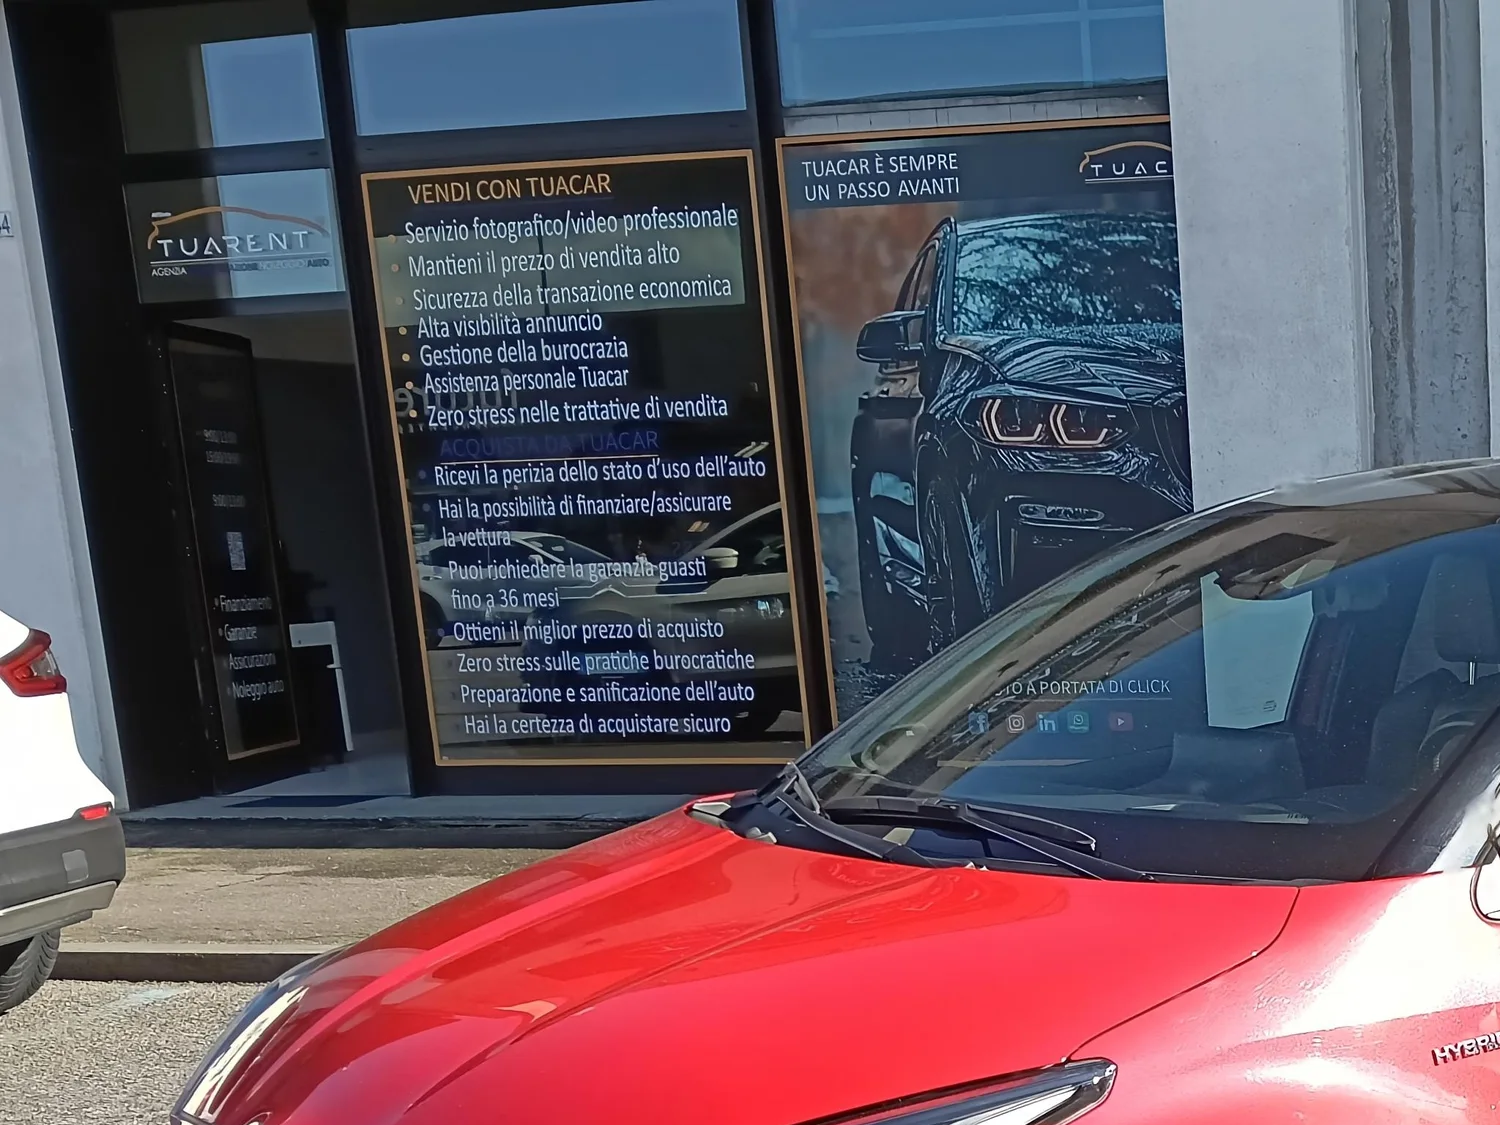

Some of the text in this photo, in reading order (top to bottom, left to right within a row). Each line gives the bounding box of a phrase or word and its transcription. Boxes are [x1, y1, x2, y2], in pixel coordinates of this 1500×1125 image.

[801, 153, 959, 178] TUACAR È SEMPRE
[1090, 161, 1168, 177] TUAC
[408, 173, 612, 204] VENDI CON TUACAR
[804, 177, 960, 202] UN PASSO AVANTI
[405, 202, 739, 244] Servizio fotografico/video professionale
[157, 231, 308, 257] TUARENT
[151, 266, 187, 278] AGENZIA
[408, 241, 681, 278] Mantieni il prezzo di vendita alto
[413, 274, 732, 311] Sicurezza della transazione economica
[418, 309, 603, 339] Alta visibilità annuncio
[420, 336, 629, 366] Gestione della burocrazia
[425, 365, 629, 396] Assistenza personale Tuacar
[427, 405, 465, 427] Zero
[469, 404, 516, 426] stress
[520, 399, 560, 424] nelle
[564, 398, 641, 422] trattative
[645, 395, 661, 419] di
[664, 393, 729, 417] vendita
[440, 431, 660, 458] ACQUISTA DA TUACAR
[434, 464, 480, 487] Ricevi
[484, 463, 498, 485] la
[503, 463, 555, 489] perizia
[559, 459, 599, 482] dello
[602, 461, 643, 481] stato
[438, 491, 732, 523] Hai la possibilità di finanziare/assicurare
[442, 526, 512, 548] la vettura
[448, 555, 707, 583] Puoi richiedere la garanzia guasti
[451, 587, 560, 610] fino a 36 mesi
[453, 618, 724, 645] Ottieni il miglior prezzo di acquisto
[457, 648, 755, 676] Zero stress sulle pratiche burocratiche
[460, 684, 562, 708] Preparazione
[566, 687, 576, 702] e
[580, 681, 681, 702] sanificazione
[1026, 680, 1037, 695] A
[1040, 680, 1105, 695] PORTATA
[1109, 679, 1124, 694] DI
[1127, 679, 1171, 694] CLICK
[464, 713, 731, 738] Hai la certezza di acquistare sicuro
